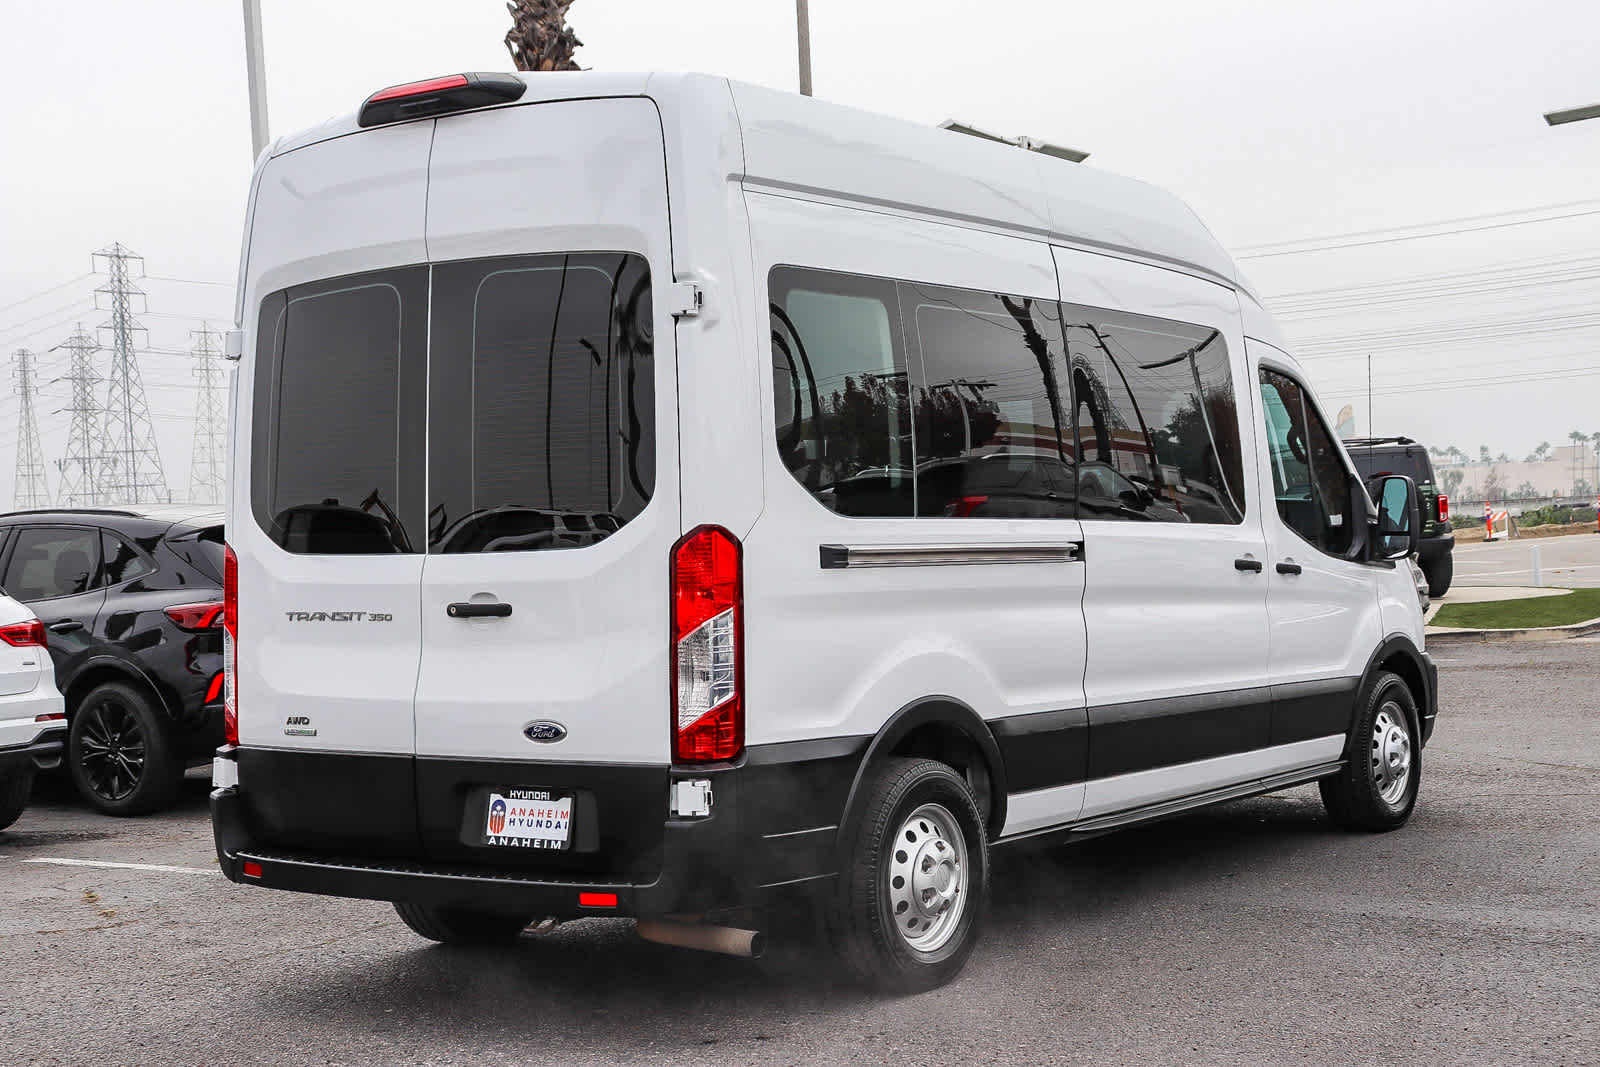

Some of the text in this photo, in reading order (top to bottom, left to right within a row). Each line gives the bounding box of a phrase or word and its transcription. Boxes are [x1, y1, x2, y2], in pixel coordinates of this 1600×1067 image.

[285, 611, 393, 622] TRANSIT 350
[286, 716, 310, 726] AWD
[509, 789, 550, 800] HYUNDAI
[510, 807, 569, 819] ANAHEIM
[508, 818, 567, 830] HYUNDAI
[487, 836, 562, 849] ANAHEIM
